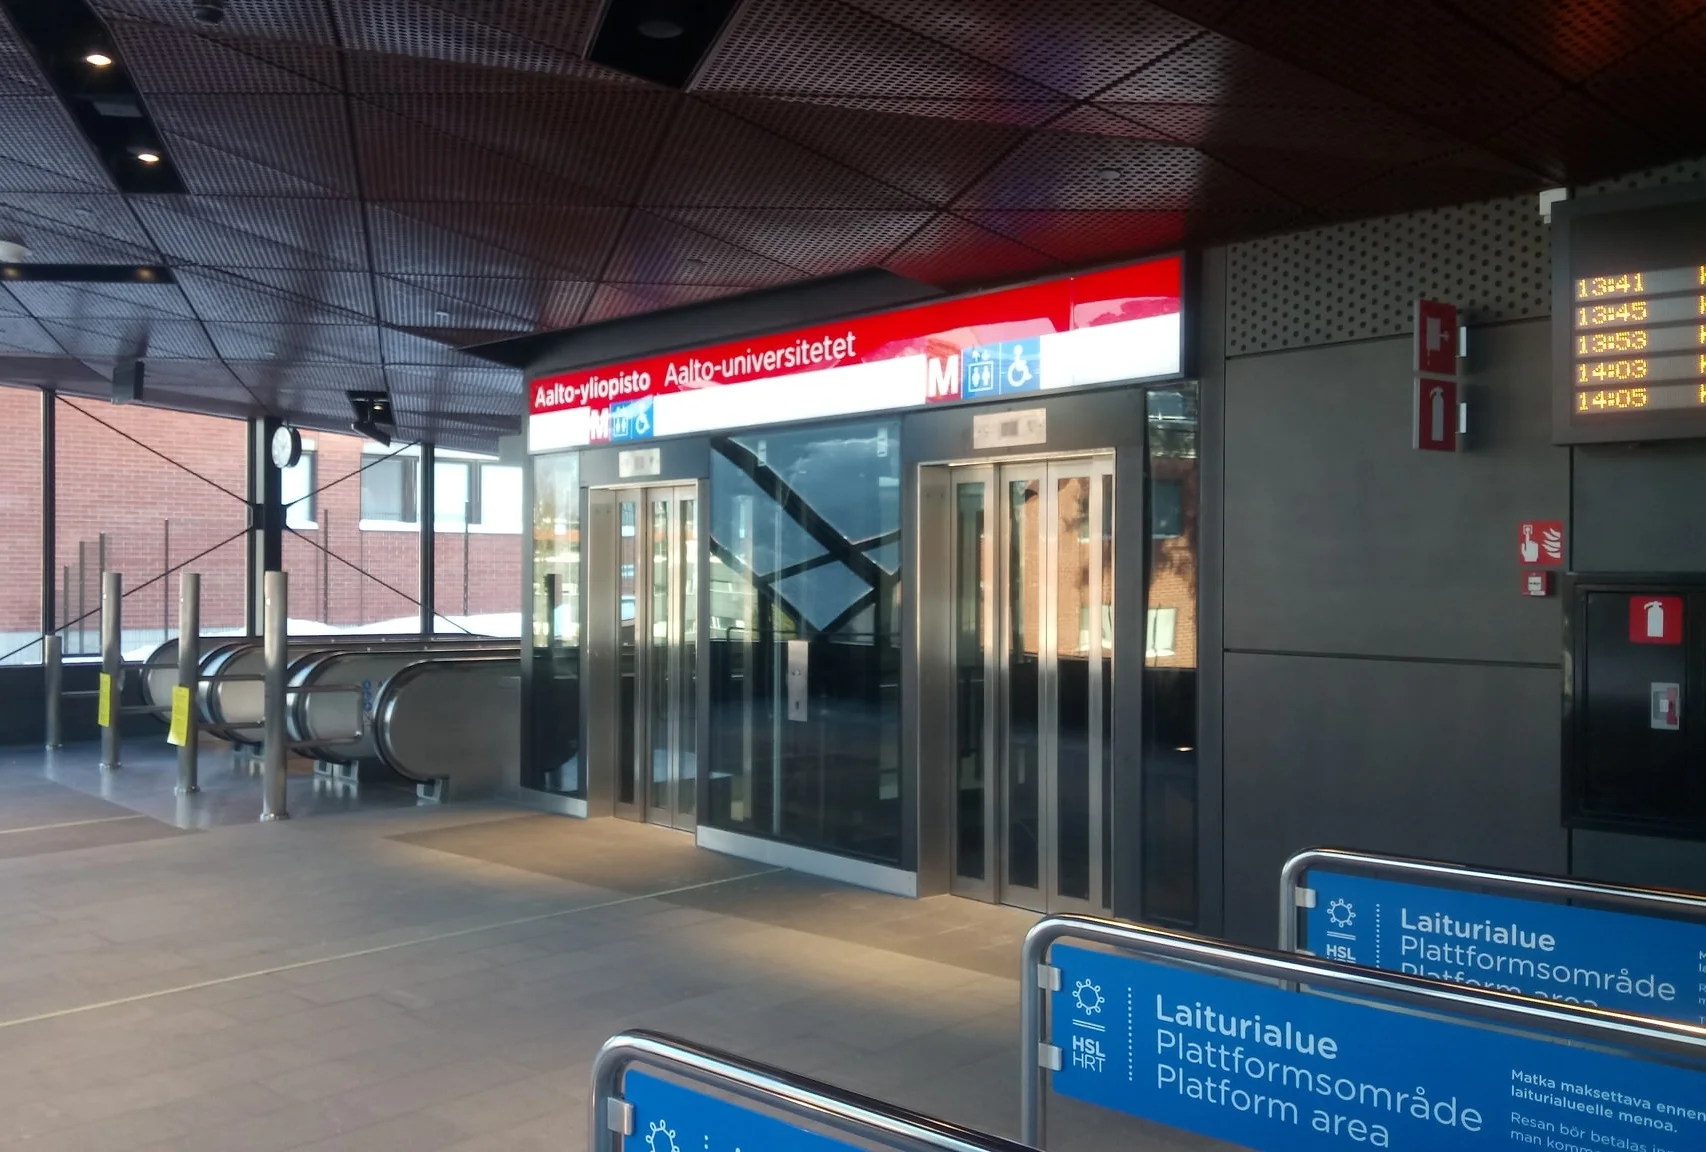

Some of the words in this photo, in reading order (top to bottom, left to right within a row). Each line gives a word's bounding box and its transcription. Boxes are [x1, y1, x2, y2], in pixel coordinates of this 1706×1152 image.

[1579, 272, 1644, 298] 13:41
[1579, 301, 1648, 326] 13:45
[1579, 330, 1648, 355] 13:53
[534, 371, 652, 408] Aalto-yliopisto
[663, 331, 857, 387] Aalto-universitetet
[928, 353, 960, 397] M
[1579, 359, 1648, 383] 14:03
[1579, 388, 1648, 411] 14:05
[1402, 908, 1556, 951] Laiturialue
[1326, 944, 1356, 960] HSL
[1402, 935, 1676, 1001] Plattformsområde
[1072, 1035, 1106, 1057] HSL
[1157, 994, 1338, 1060] Laiturialue
[1073, 1051, 1106, 1072] HRT
[1157, 1029, 1483, 1132] Plattformsområde
[1157, 1063, 1298, 1125] Platform
[1312, 1109, 1389, 1148] area
[1511, 1069, 1556, 1088] Matka
[1560, 1081, 1651, 1109] maksettava
[1656, 1103, 1706, 1122] ennen
[1511, 1085, 1613, 1118] laiturialueelle
[1618, 1111, 1678, 1133] menoa.
[1510, 1130, 1542, 1146] man
[1511, 1112, 1555, 1132] Resan
[1560, 1123, 1586, 1139] bör
[1591, 1130, 1647, 1152] betalas
